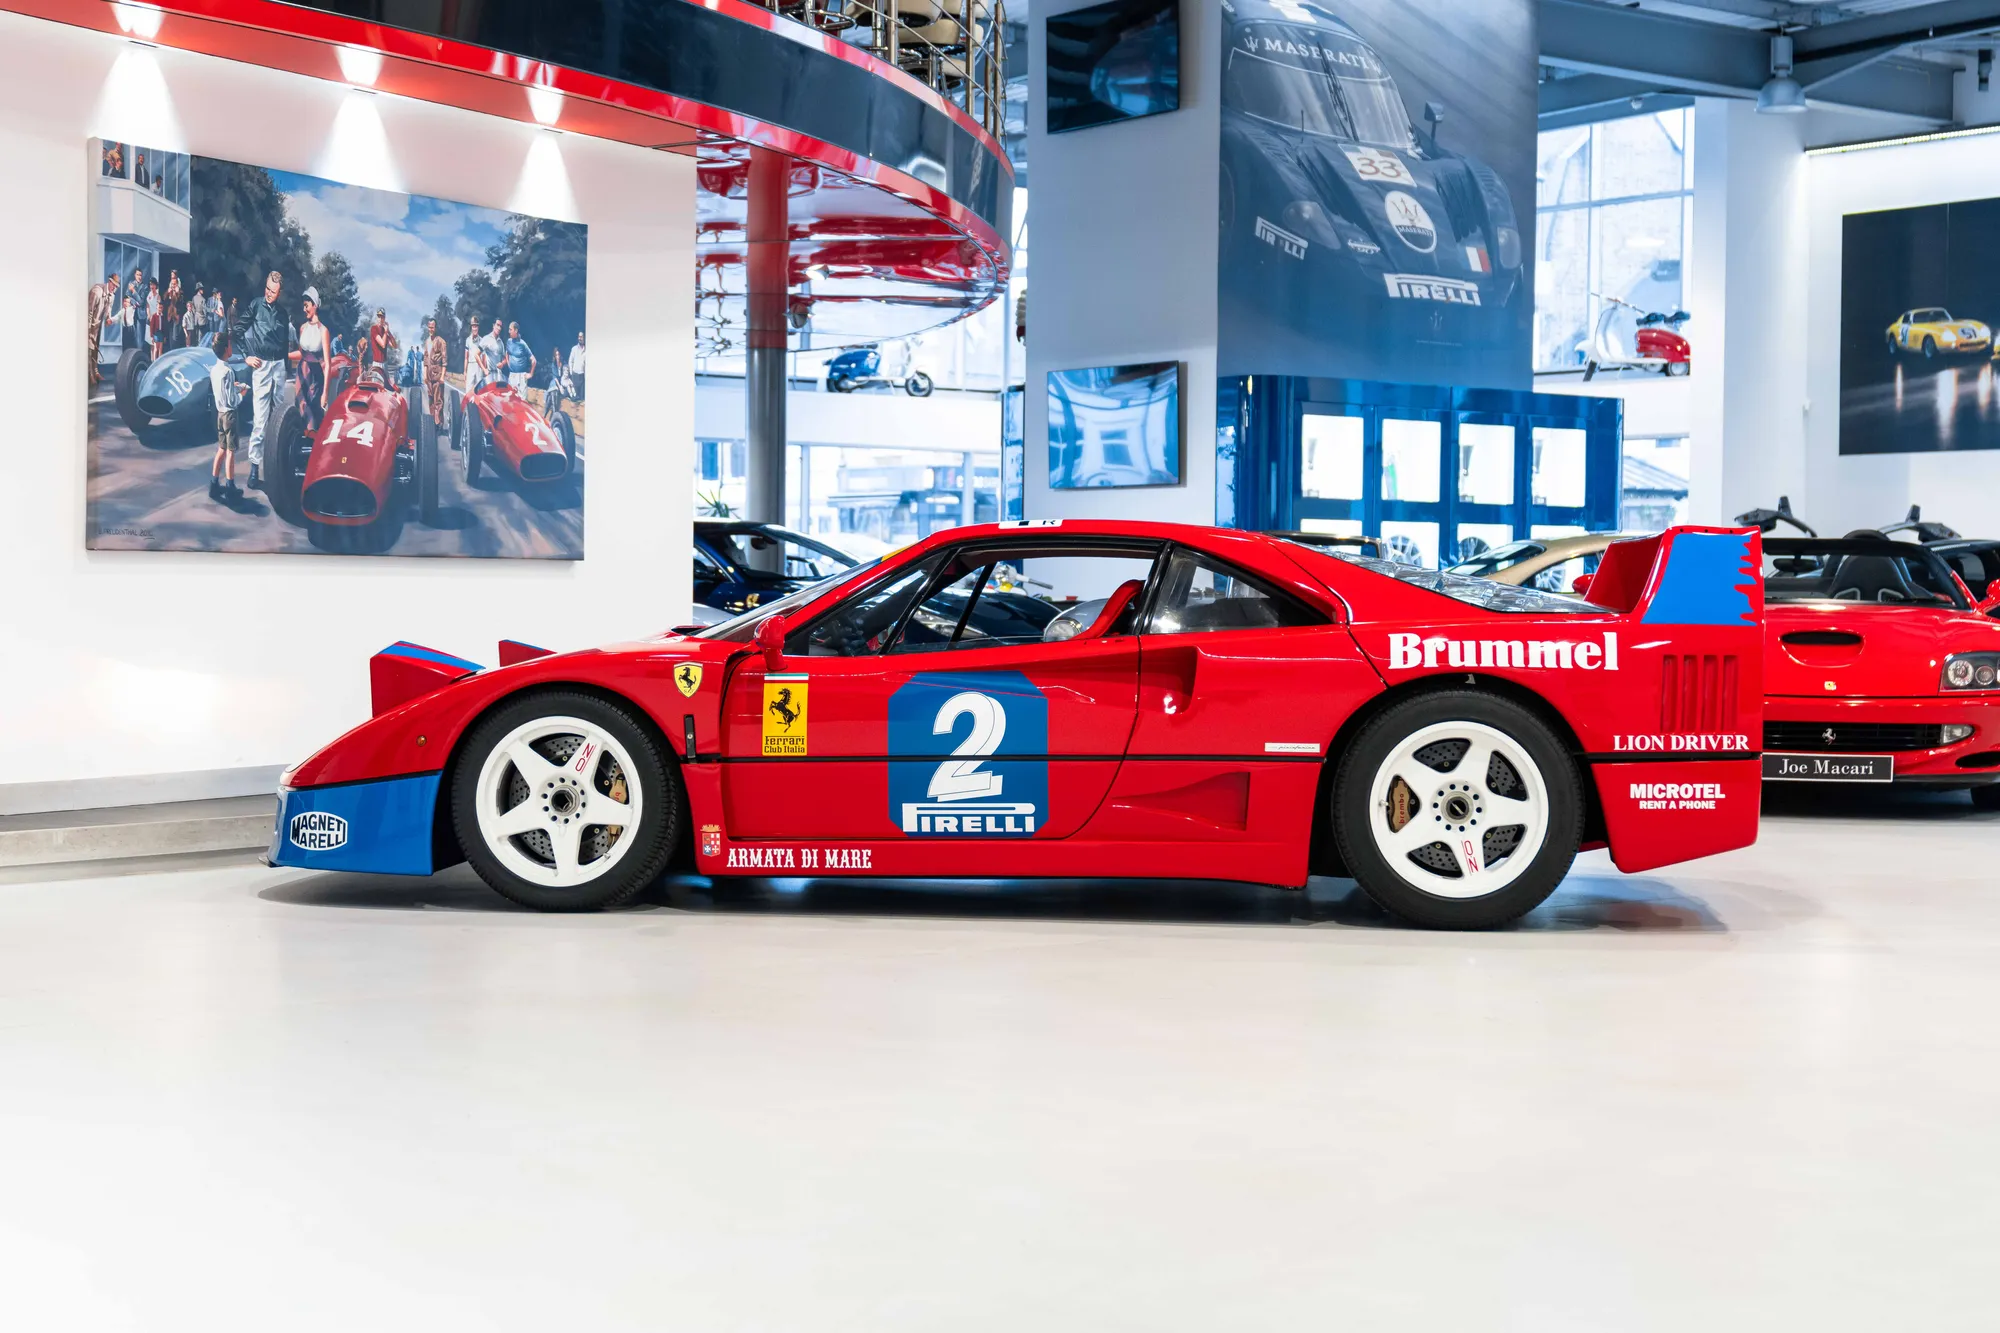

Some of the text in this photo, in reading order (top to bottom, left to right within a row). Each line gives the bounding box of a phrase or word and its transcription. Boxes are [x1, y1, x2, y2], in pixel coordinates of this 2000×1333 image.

[1264, 38, 1370, 69] MASERATI
[1357, 157, 1402, 178] 33
[1255, 216, 1309, 261] PIRLLI
[1383, 273, 1482, 306] PIRELLI
[165, 370, 193, 395] 18
[322, 419, 374, 448] 14
[525, 422, 548, 446] 2
[1387, 631, 1619, 671] Brummel
[764, 745, 805, 754] Club Italia
[765, 735, 805, 746] Ferrari
[926, 691, 1006, 802] 2
[1613, 734, 1749, 751] LION DRIVER
[1779, 758, 1874, 775] Joe Macari
[1630, 783, 1726, 799] MICROTEL
[1639, 800, 1716, 810] RENT A PHONE
[902, 803, 1036, 832] PIRELLI
[726, 848, 872, 869] ARMATA DI MARE
